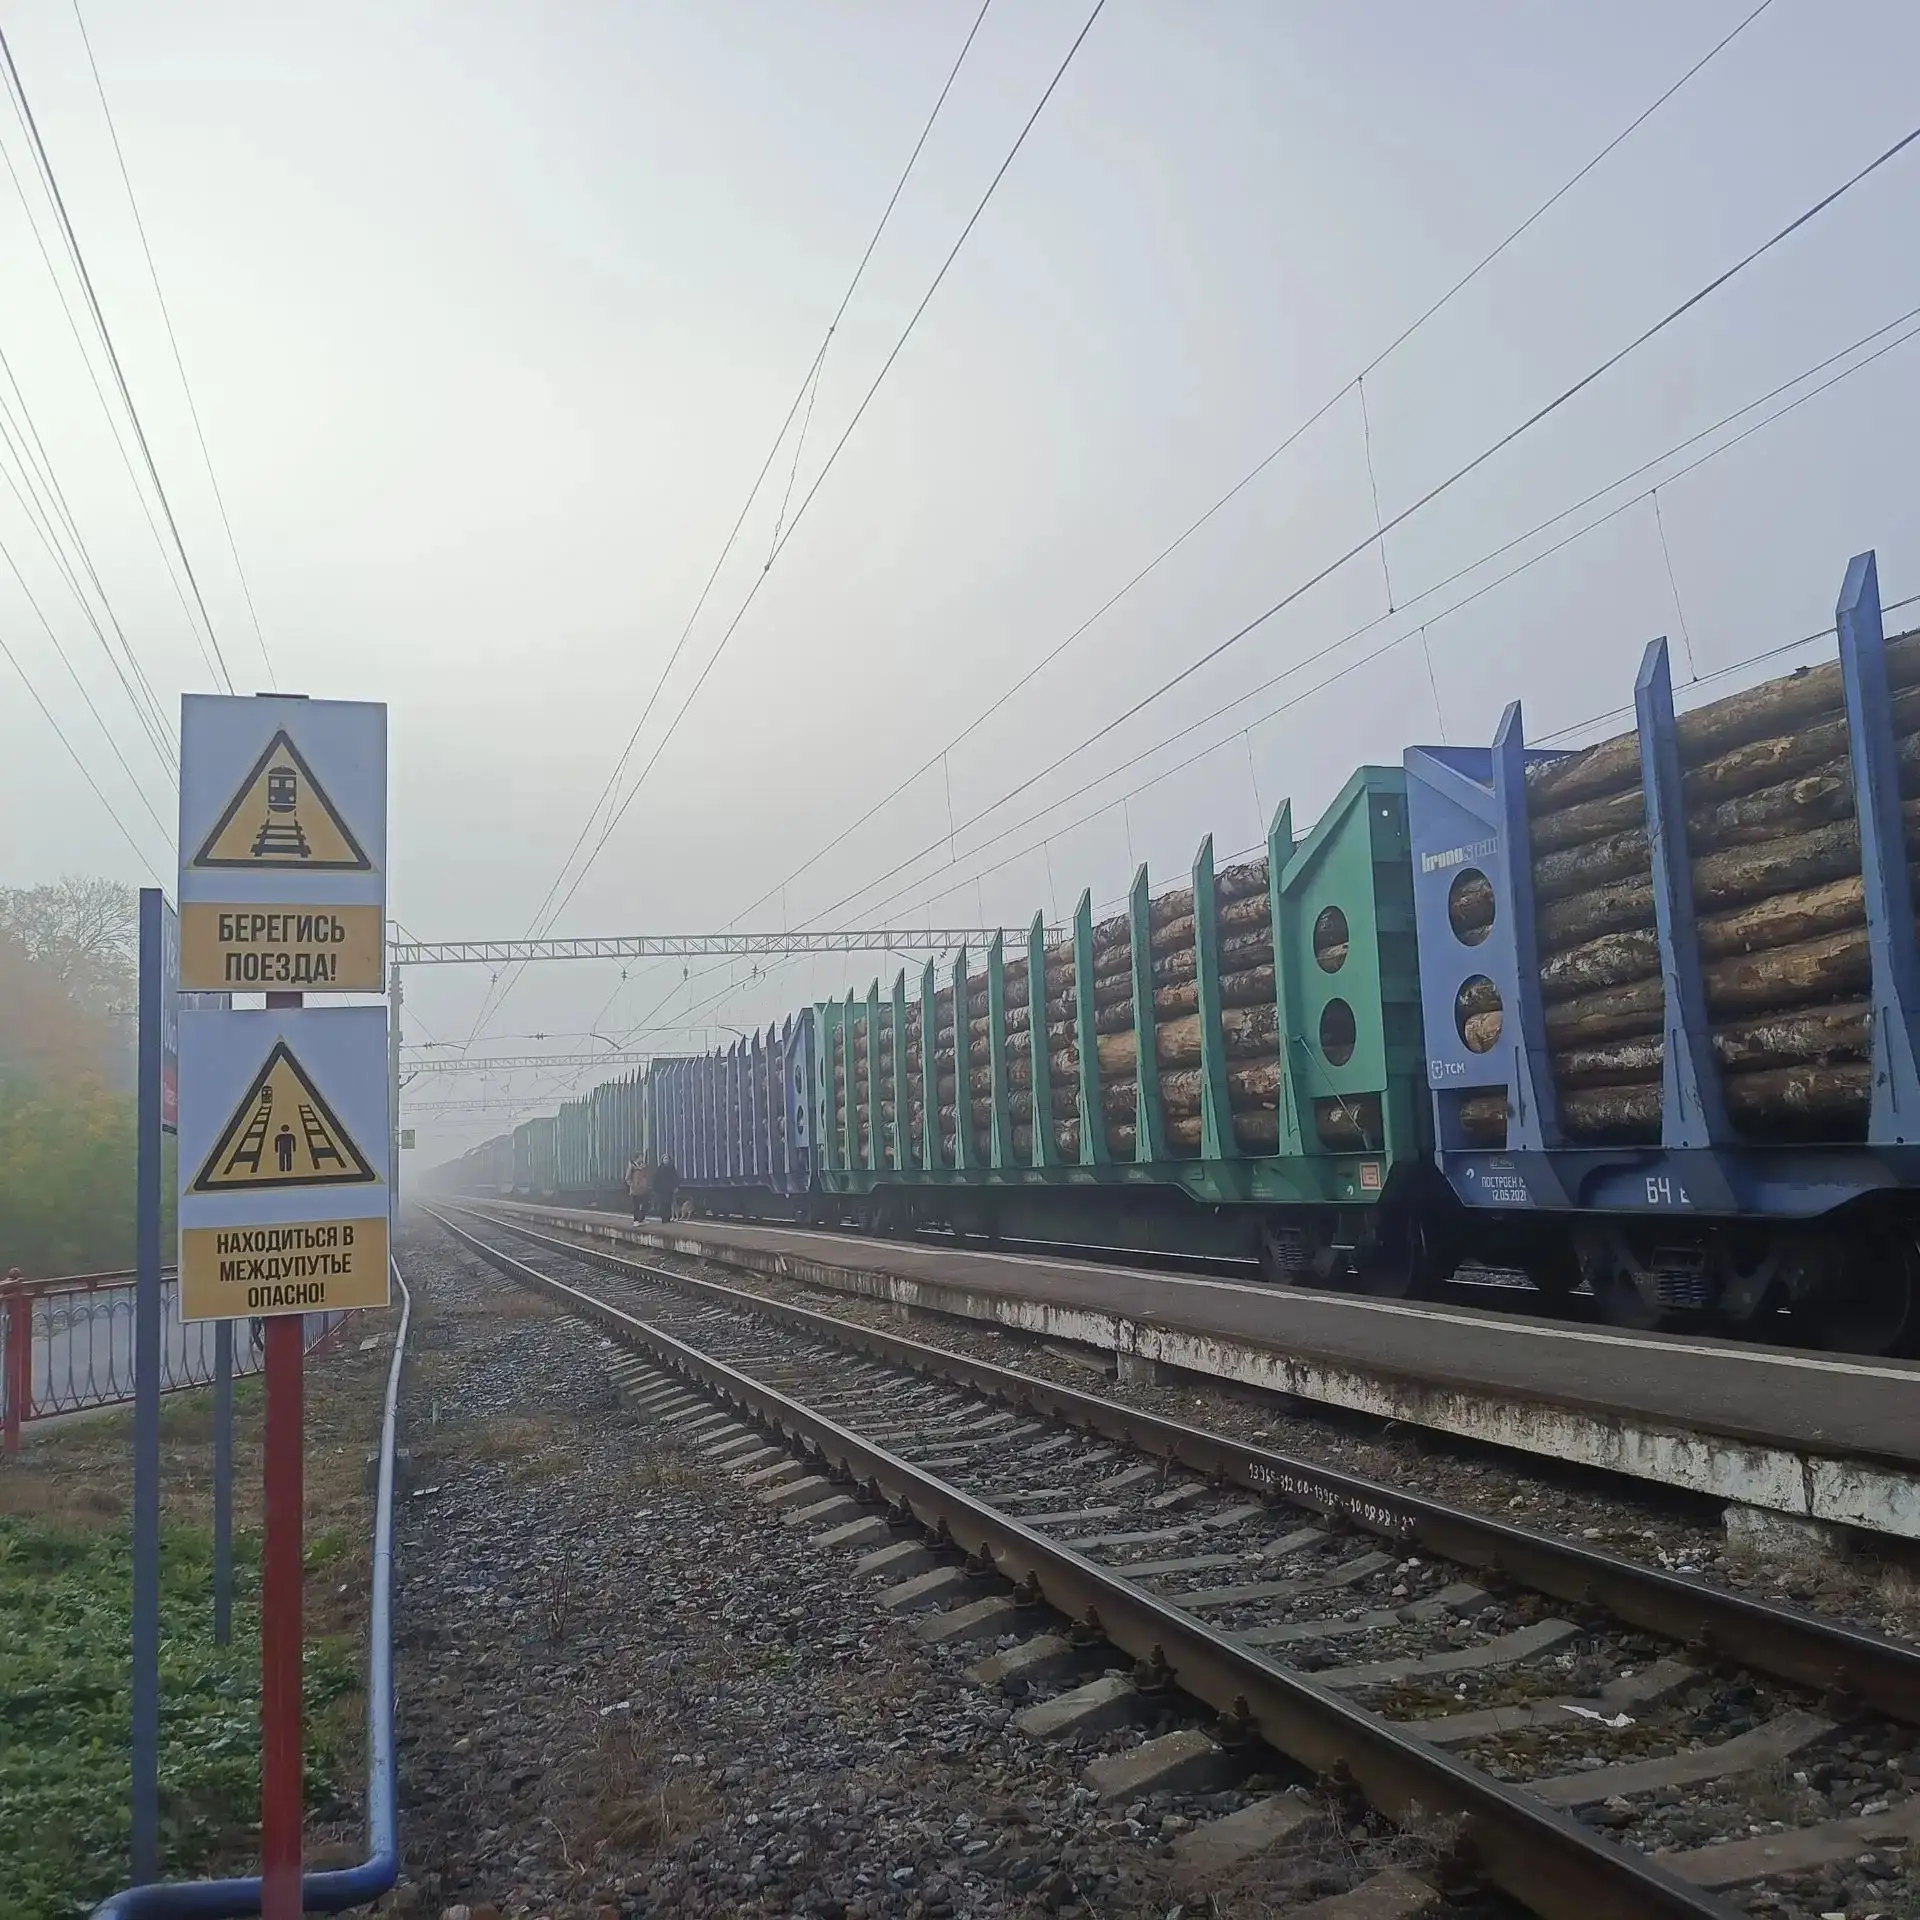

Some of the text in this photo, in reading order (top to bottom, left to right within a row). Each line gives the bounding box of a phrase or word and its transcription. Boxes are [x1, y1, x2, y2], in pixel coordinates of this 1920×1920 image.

[219, 913, 345, 943] БЕРЕГИСЬ
[225, 953, 337, 984] ПОЕЗДА!
[1481, 1176, 1517, 1188] ПОСТРОЕН
[216, 1225, 354, 1254] НАХОДИТЬСЯ В
[220, 1253, 352, 1281] МЕЖДУПУТЬЕ
[248, 1282, 325, 1308] ОПАСНО!
